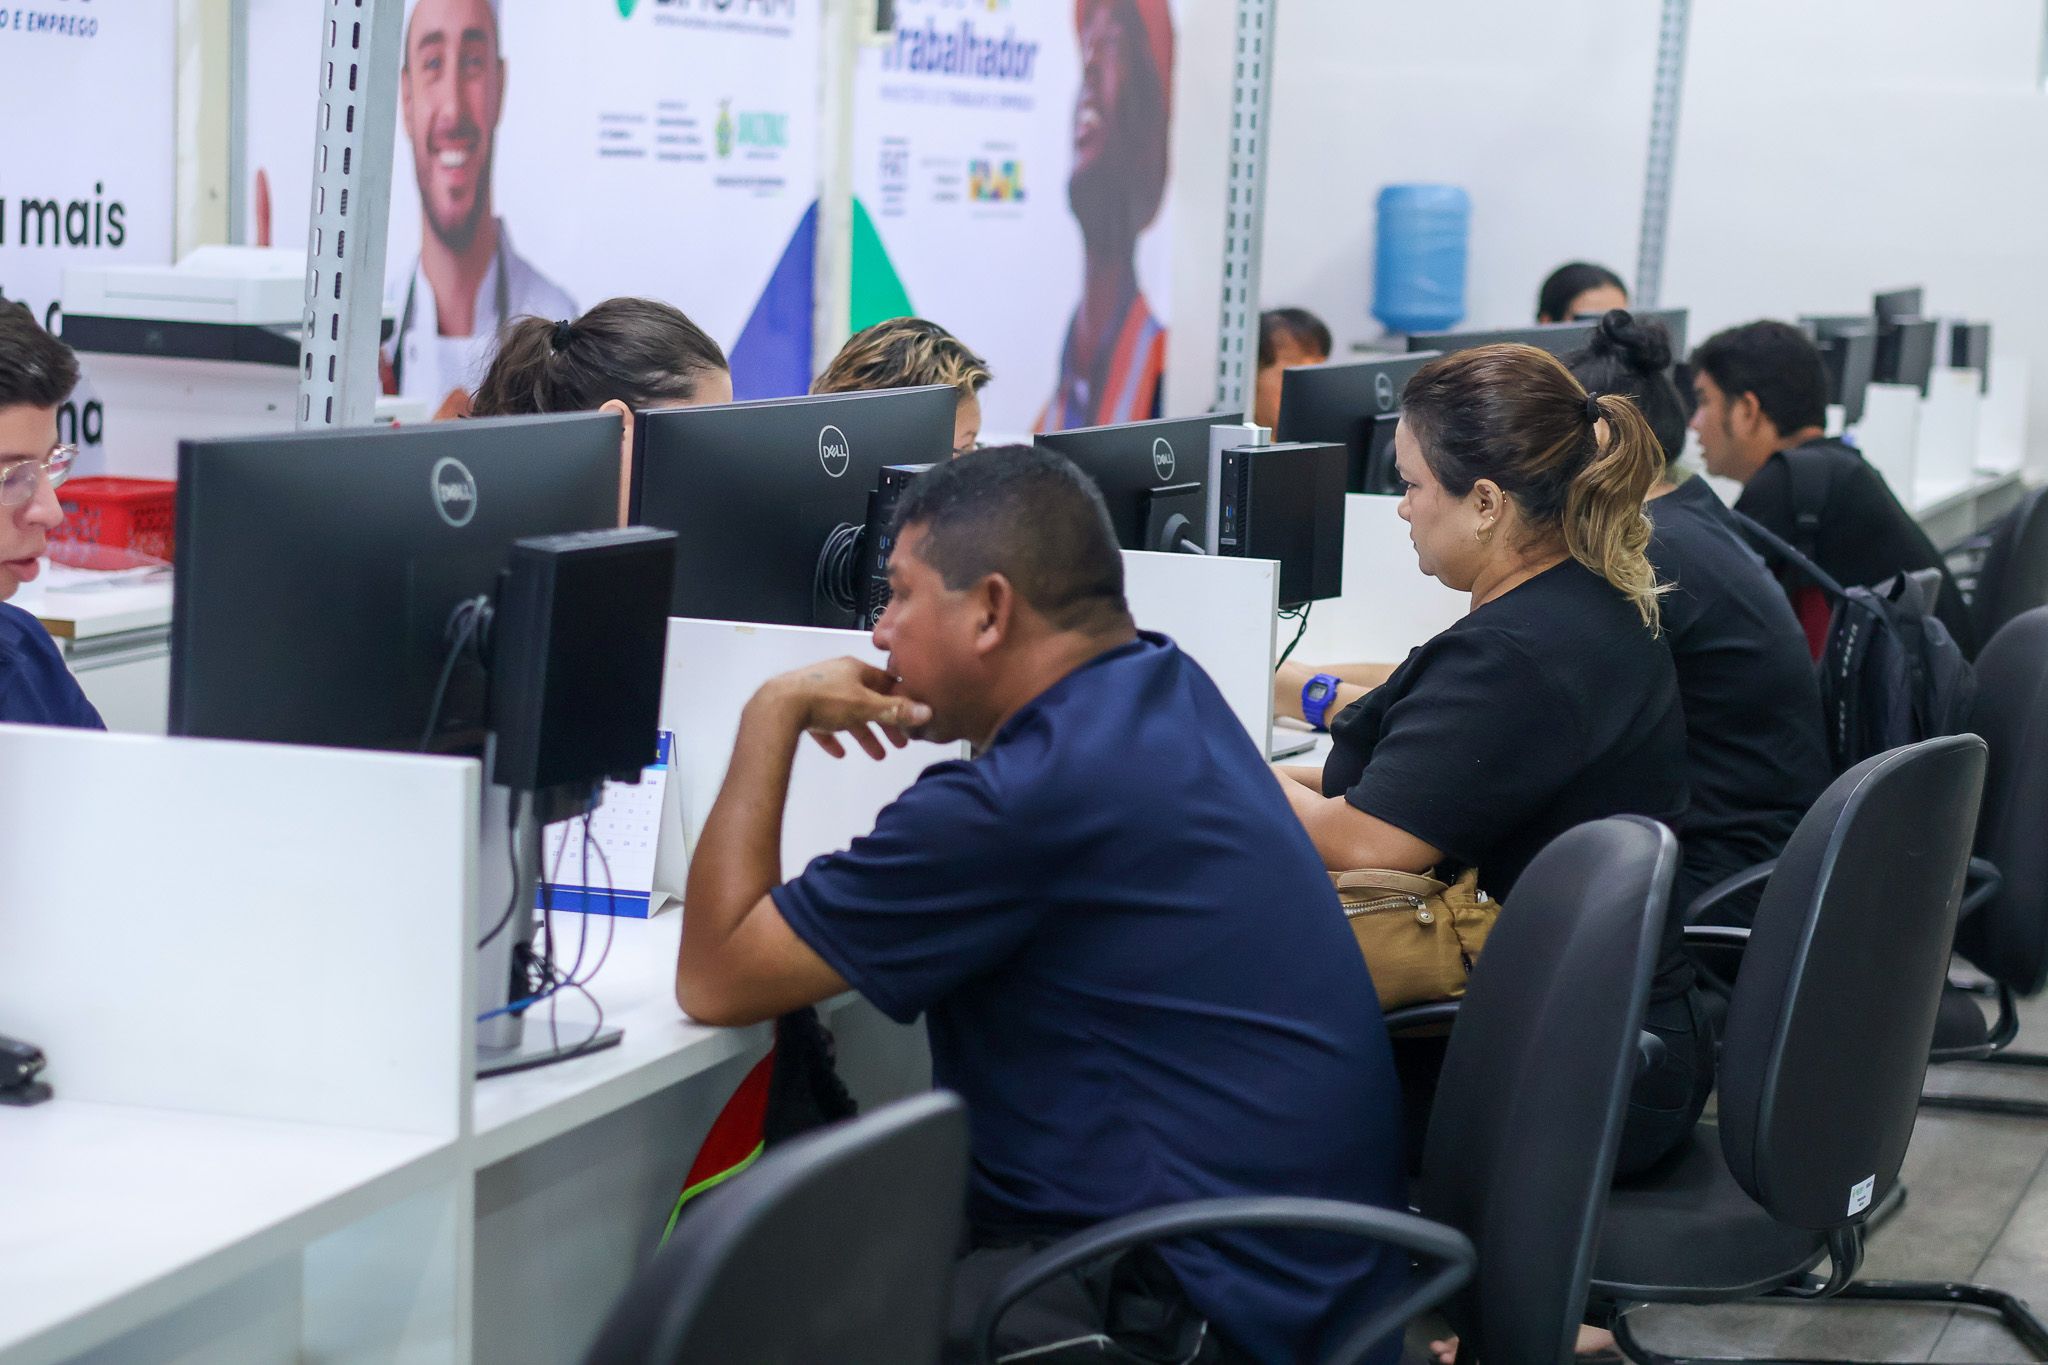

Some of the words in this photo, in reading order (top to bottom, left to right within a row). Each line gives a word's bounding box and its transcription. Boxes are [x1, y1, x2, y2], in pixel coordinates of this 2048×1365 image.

[27, 10, 98, 37] EMPREGO
[20, 182, 126, 246] mais
[822, 444, 847, 458] DELL
[1156, 453, 1174, 465] DELL
